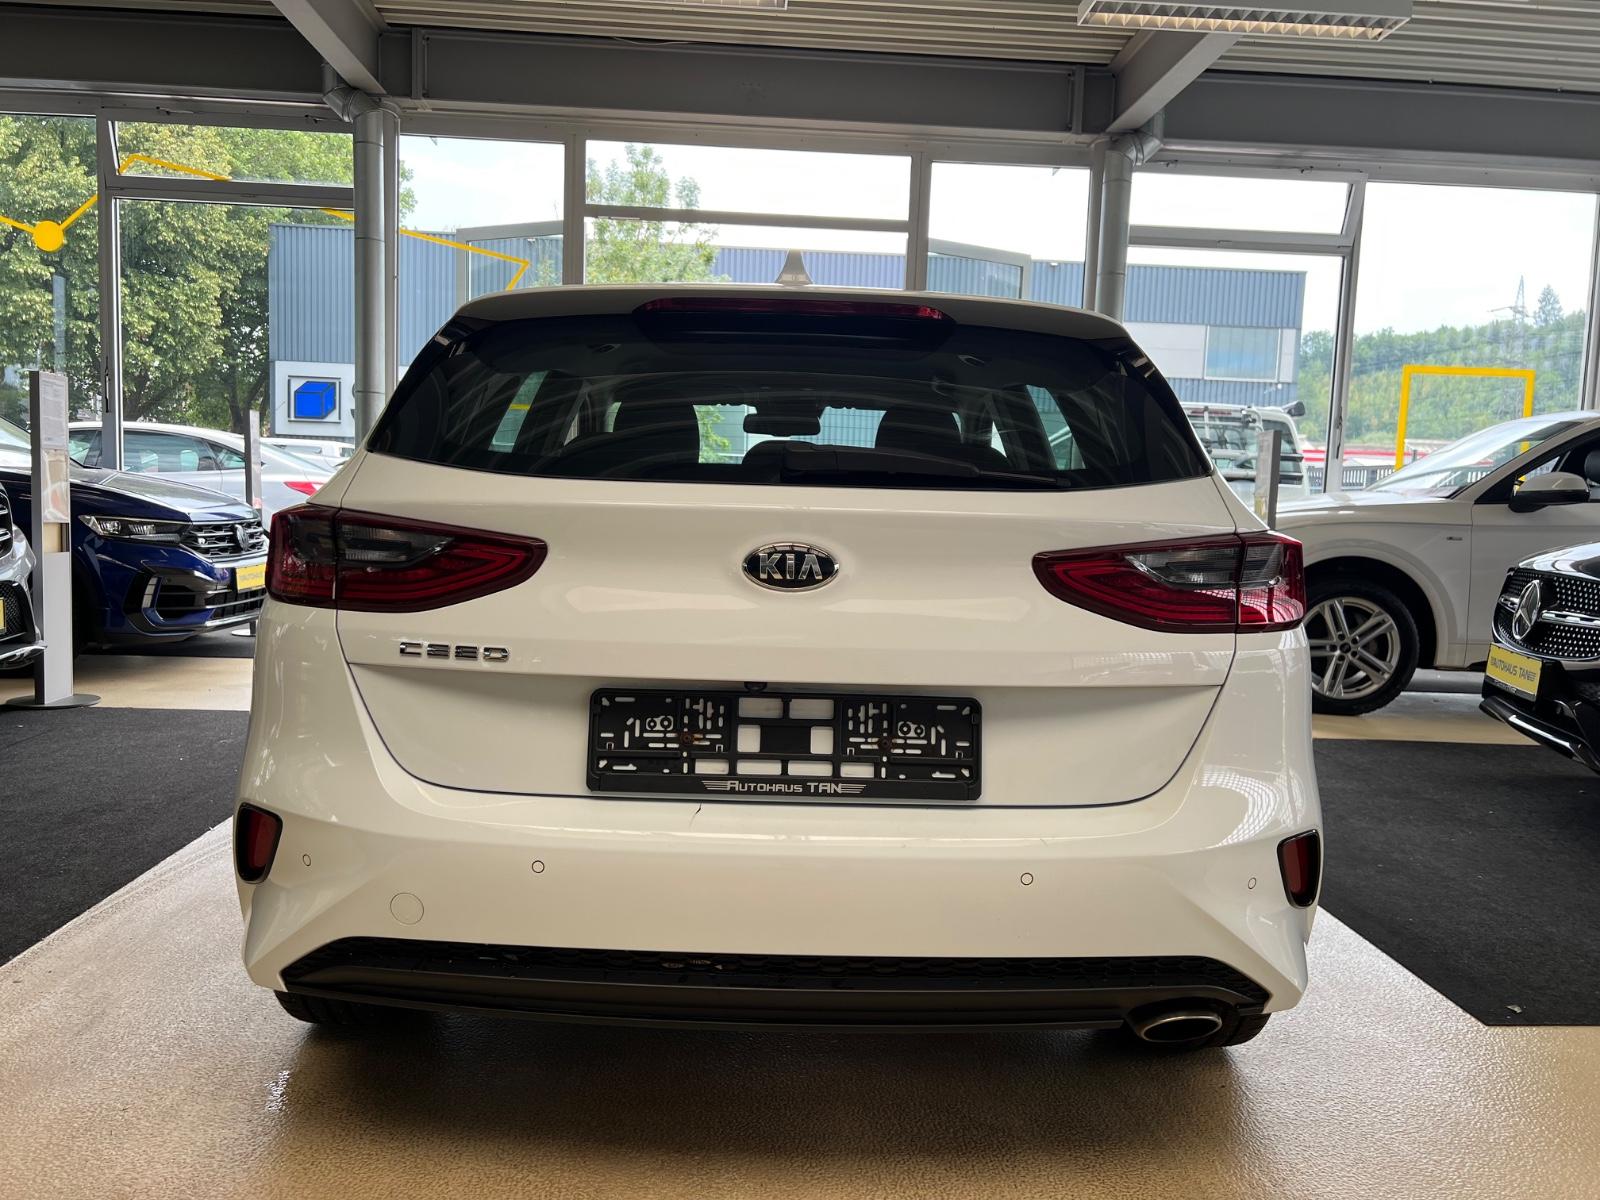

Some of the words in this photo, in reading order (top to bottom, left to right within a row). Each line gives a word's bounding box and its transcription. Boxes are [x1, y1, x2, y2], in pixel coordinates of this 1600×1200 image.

[759, 553, 823, 580] KIA
[399, 641, 509, 661] CEED
[727, 780, 803, 793] AUTOHAUS
[806, 782, 842, 794] TAN
